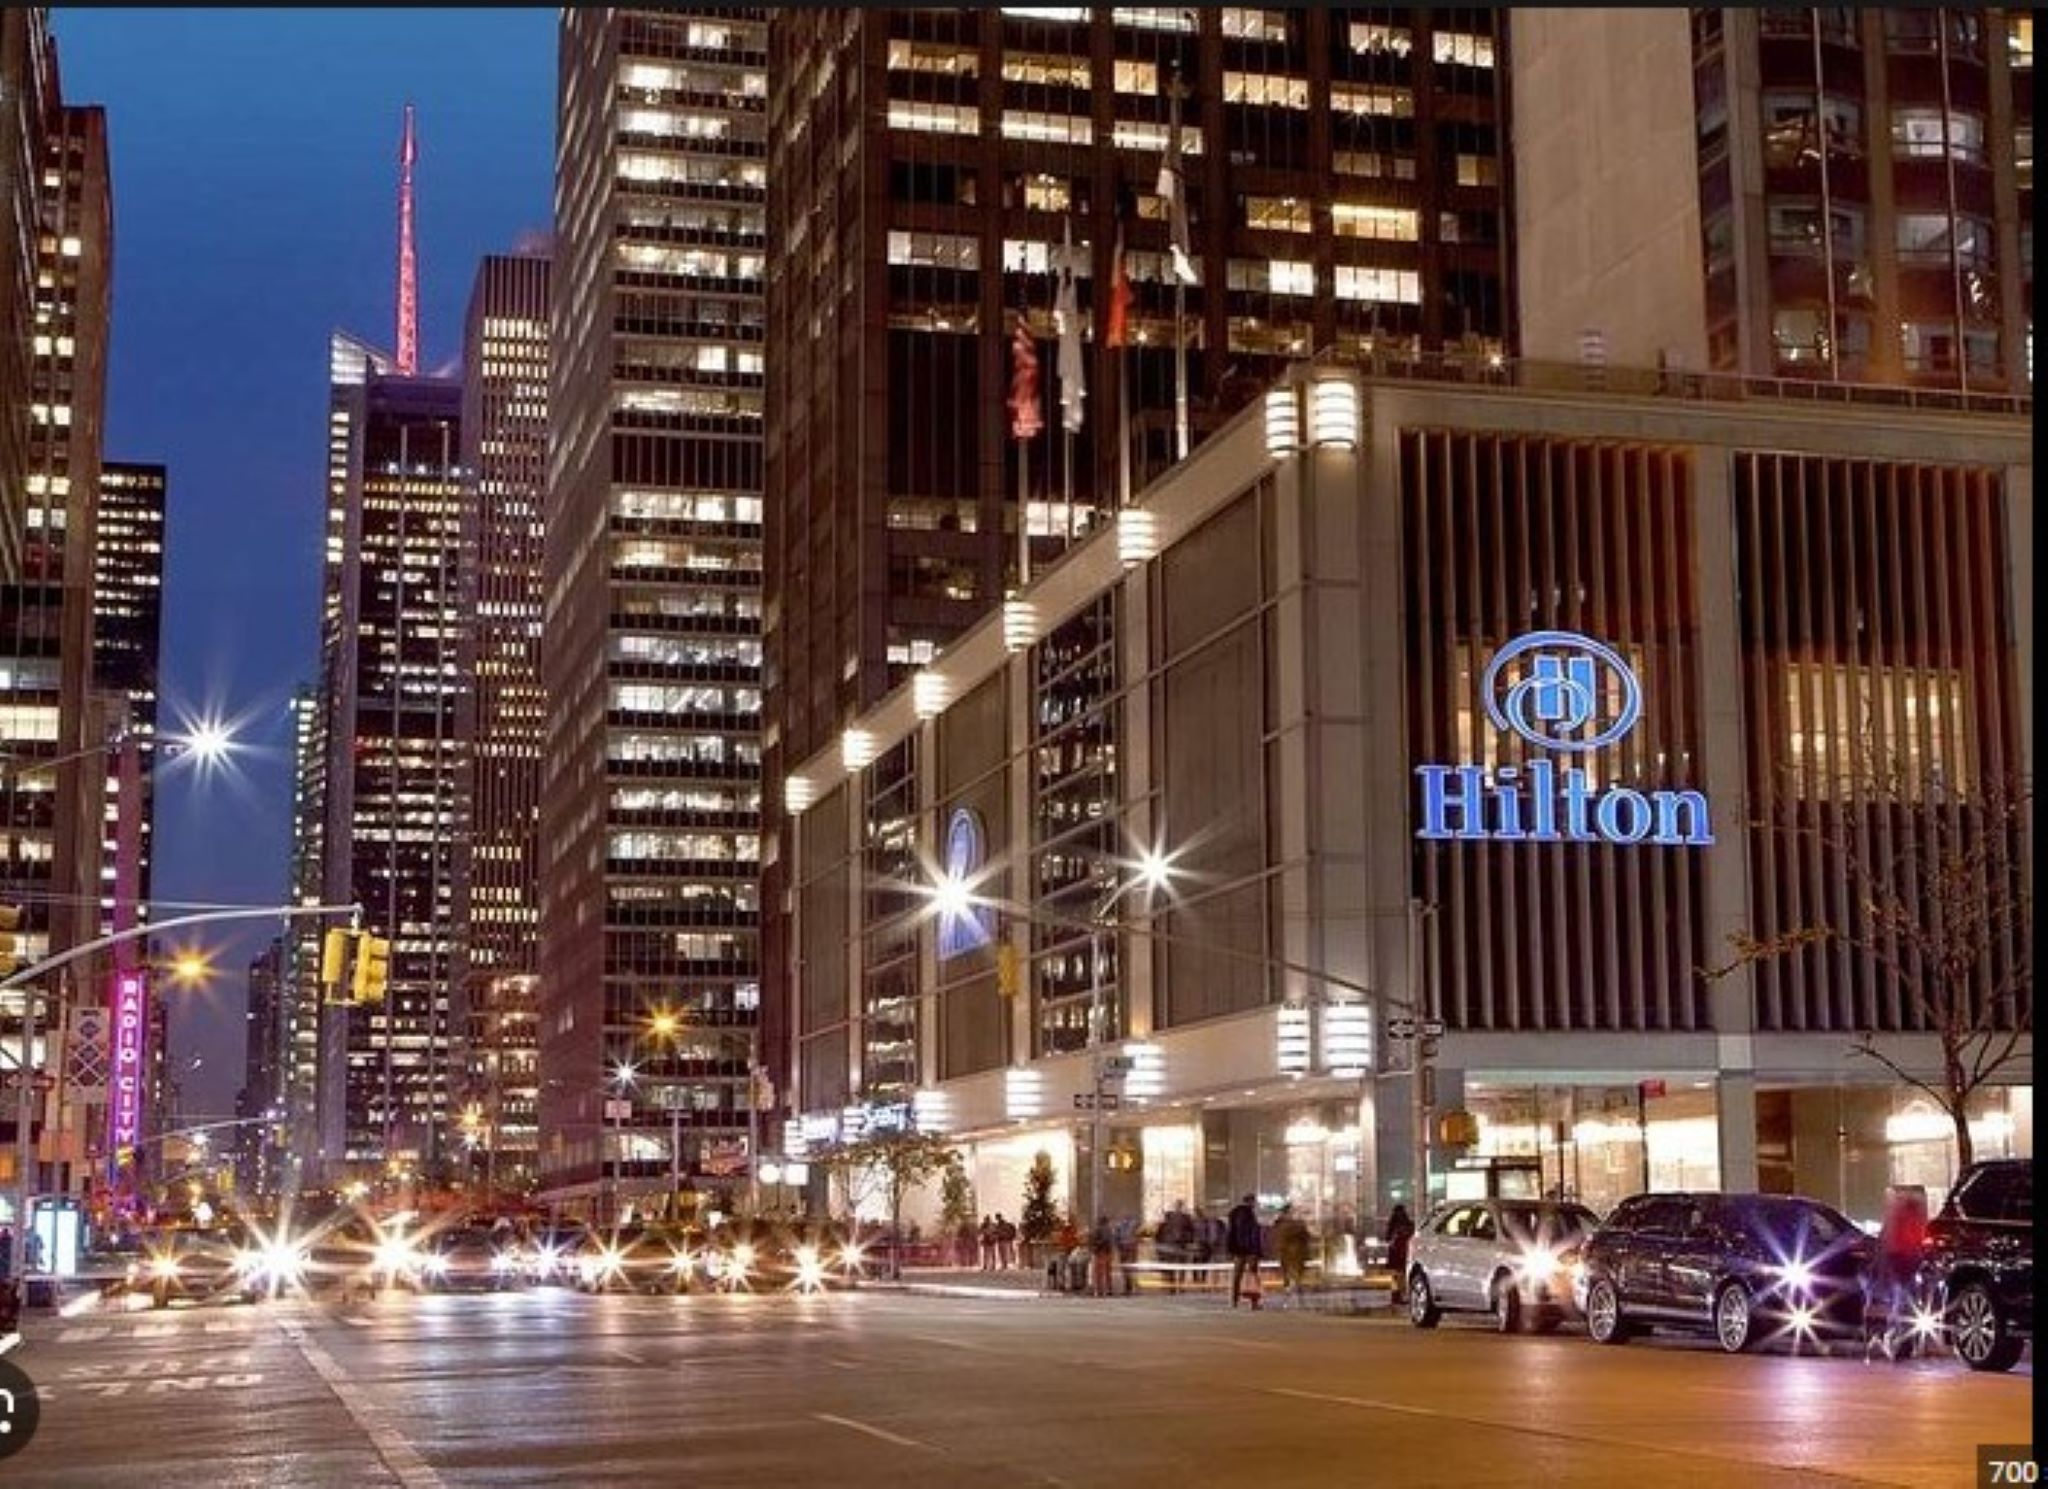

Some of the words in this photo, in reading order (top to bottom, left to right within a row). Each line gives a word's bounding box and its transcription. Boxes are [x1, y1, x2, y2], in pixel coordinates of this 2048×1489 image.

[1415, 759, 1715, 844] Hilton
[121, 980, 137, 1063] RADIO
[116, 1075, 134, 1142] CITY
